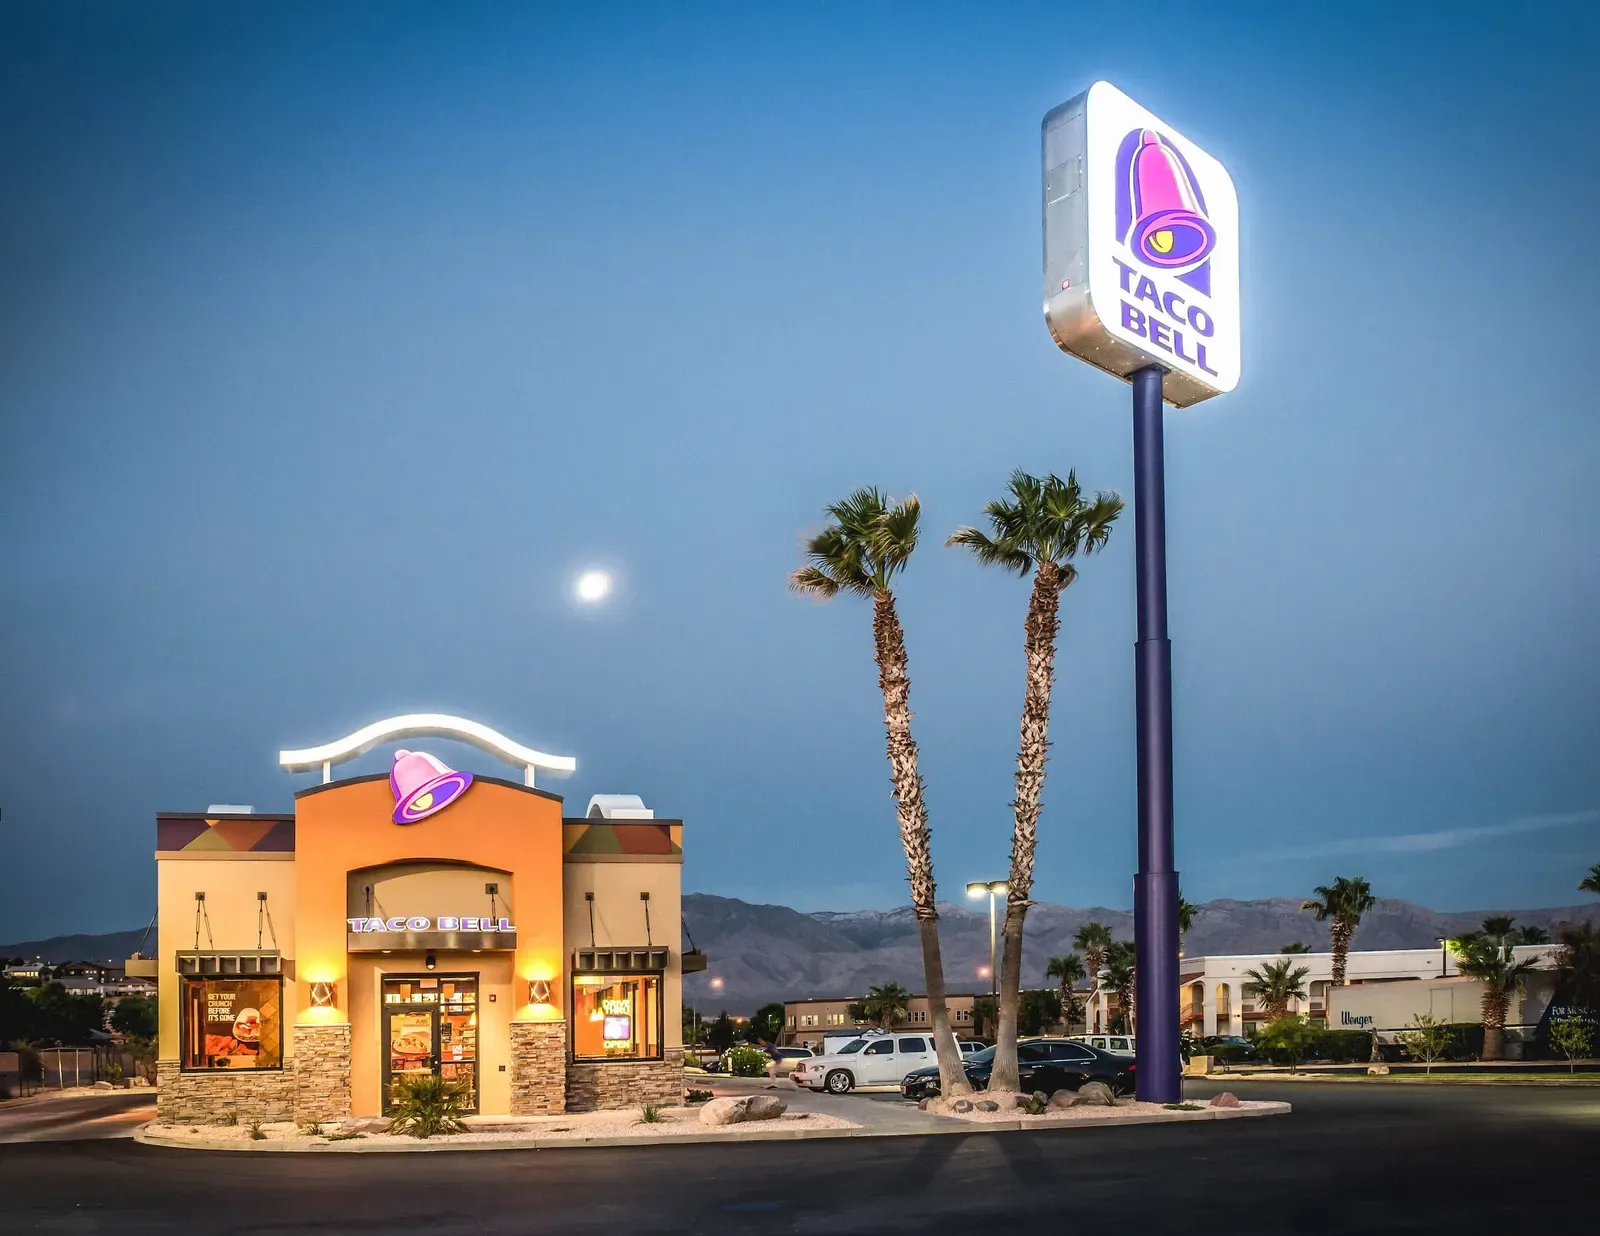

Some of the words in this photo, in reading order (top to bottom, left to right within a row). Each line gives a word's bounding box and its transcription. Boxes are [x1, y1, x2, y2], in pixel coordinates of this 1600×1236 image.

[1112, 256, 1214, 337] TACO
[1120, 299, 1218, 377] BELL
[347, 917, 430, 932] TACO
[437, 917, 517, 932] BELL
[602, 1000, 631, 1008] DRIVE
[1341, 1011, 1374, 1028] Wenger
[603, 1041, 630, 1049] OPEN
